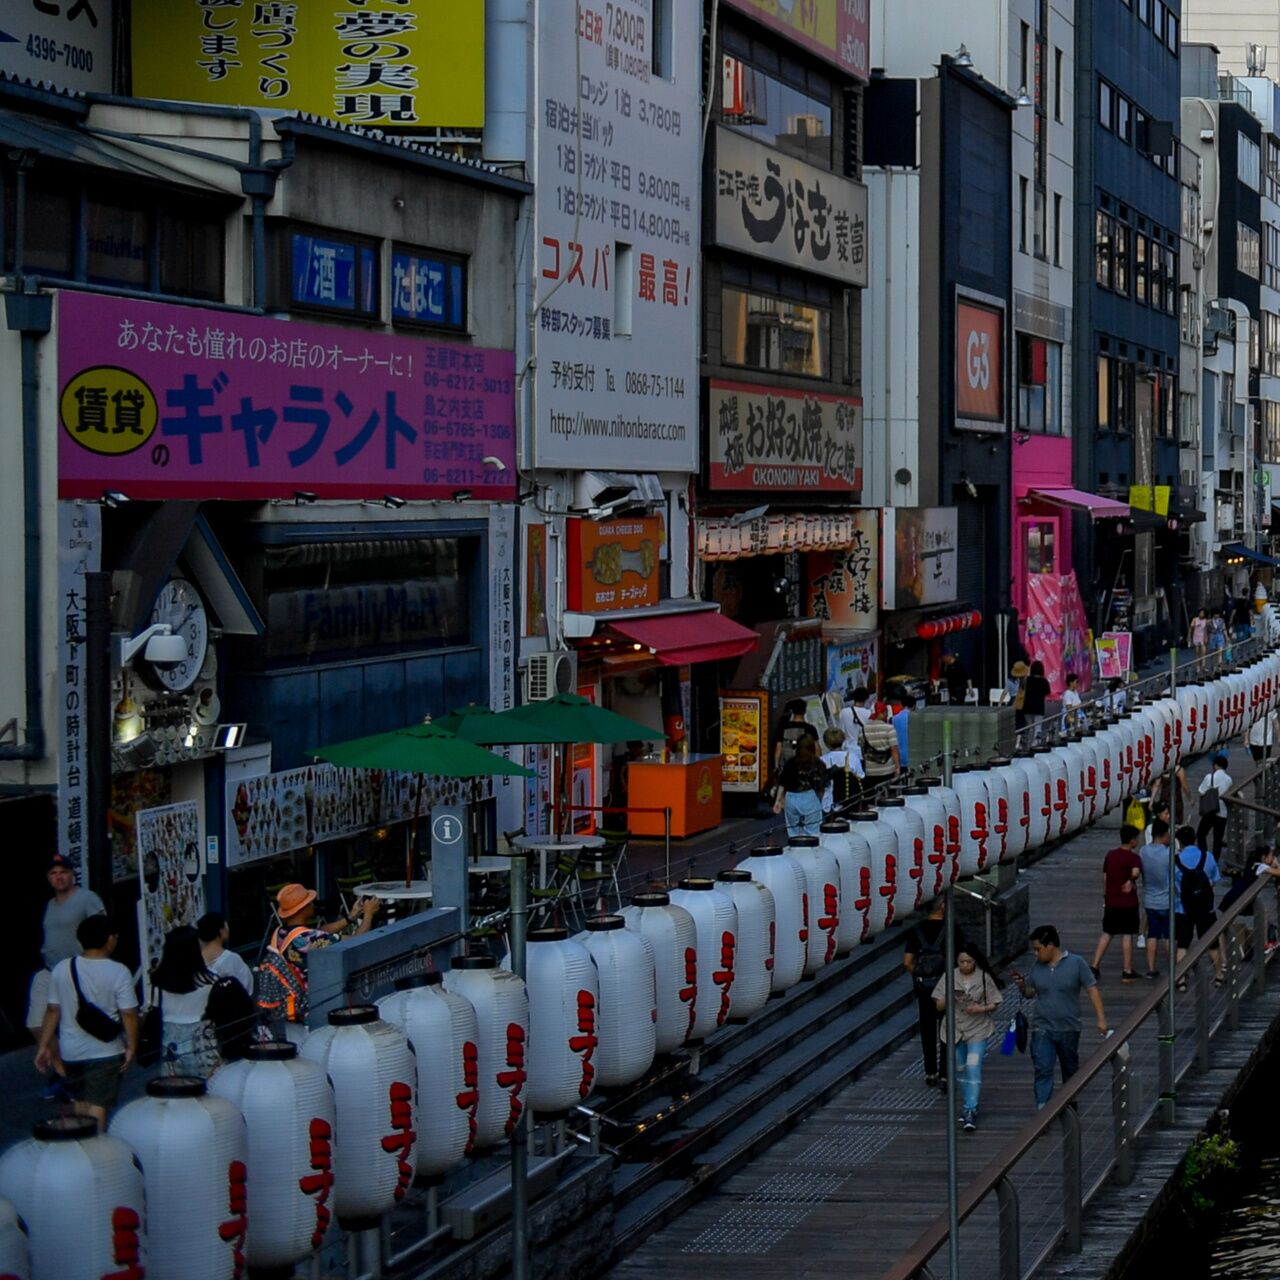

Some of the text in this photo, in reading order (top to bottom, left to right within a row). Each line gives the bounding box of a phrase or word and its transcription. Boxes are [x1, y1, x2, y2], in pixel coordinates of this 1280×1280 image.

[26, 33, 93, 74] 4396-7000
[606, 2, 646, 53] 7,800円
[582, 75, 682, 138] ロッジ 1泊 3,780円
[610, 160, 632, 193] 平日
[610, 201, 632, 231] 平日
[741, 157, 834, 262] うなぎ
[313, 243, 337, 303] 酒
[392, 263, 444, 317] たばこ
[543, 235, 691, 307] コスパ 最高!
[117, 319, 415, 379] あなたも憧れのお店のオーナーに!
[541, 306, 611, 342] 幹部スタッフ募集
[551, 360, 685, 400] 予約受付 0868-75-1144
[968, 329, 990, 392] G3
[73, 370, 419, 471] 賃貸 の ギャラント
[551, 408, 686, 441] http://www.nihonbaracc.com
[745, 396, 824, 463] お好み焼
[752, 467, 820, 487] OKONOMIYAKI
[65, 587, 81, 788] 大阪下町の時計台
